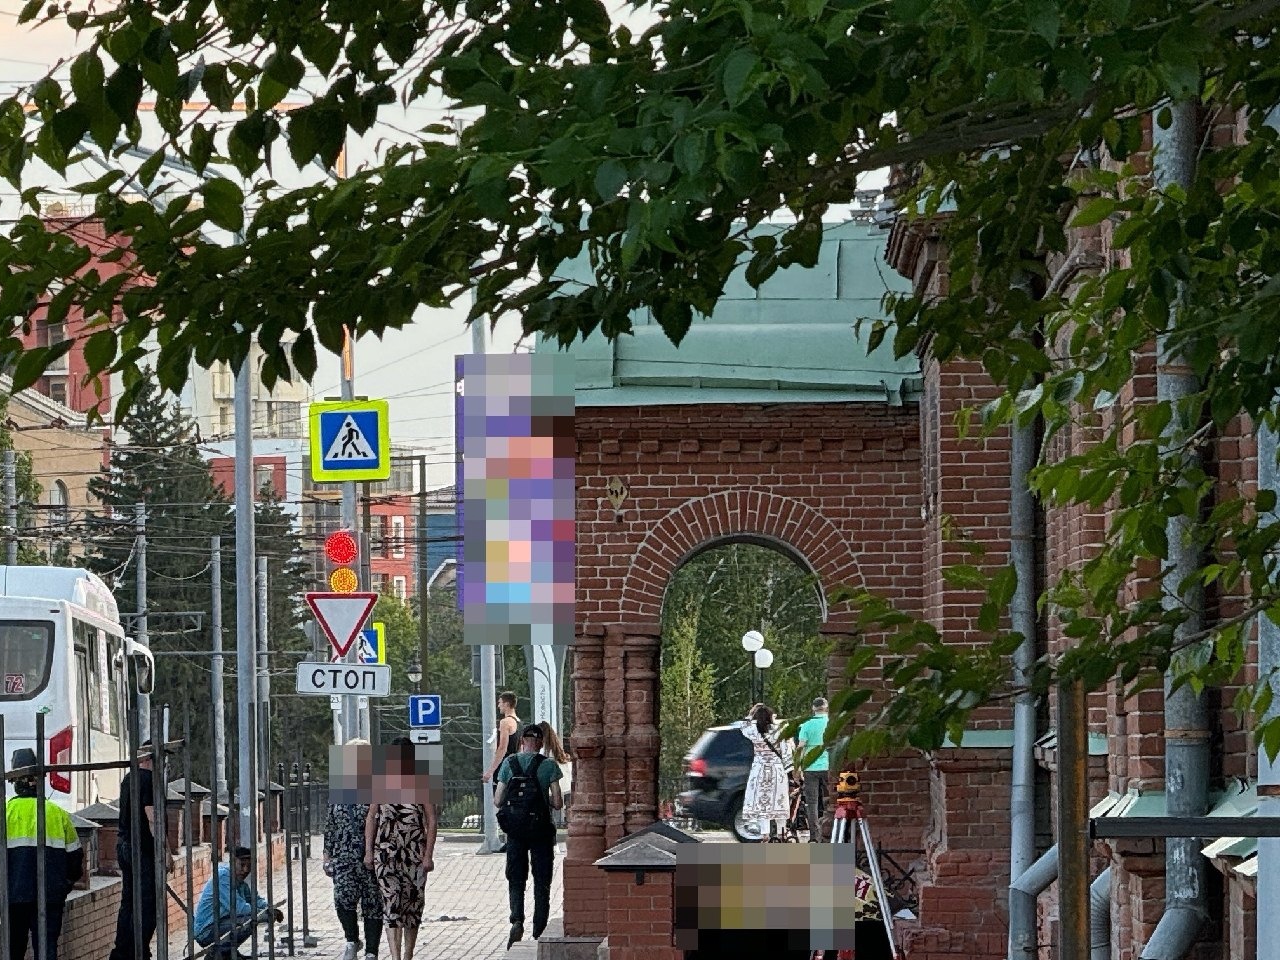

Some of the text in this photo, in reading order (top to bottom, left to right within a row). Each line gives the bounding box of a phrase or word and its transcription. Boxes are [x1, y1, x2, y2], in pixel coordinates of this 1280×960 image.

[5, 676, 23, 693] 72
[311, 668, 376, 691] СТОП
[417, 699, 435, 724] P
